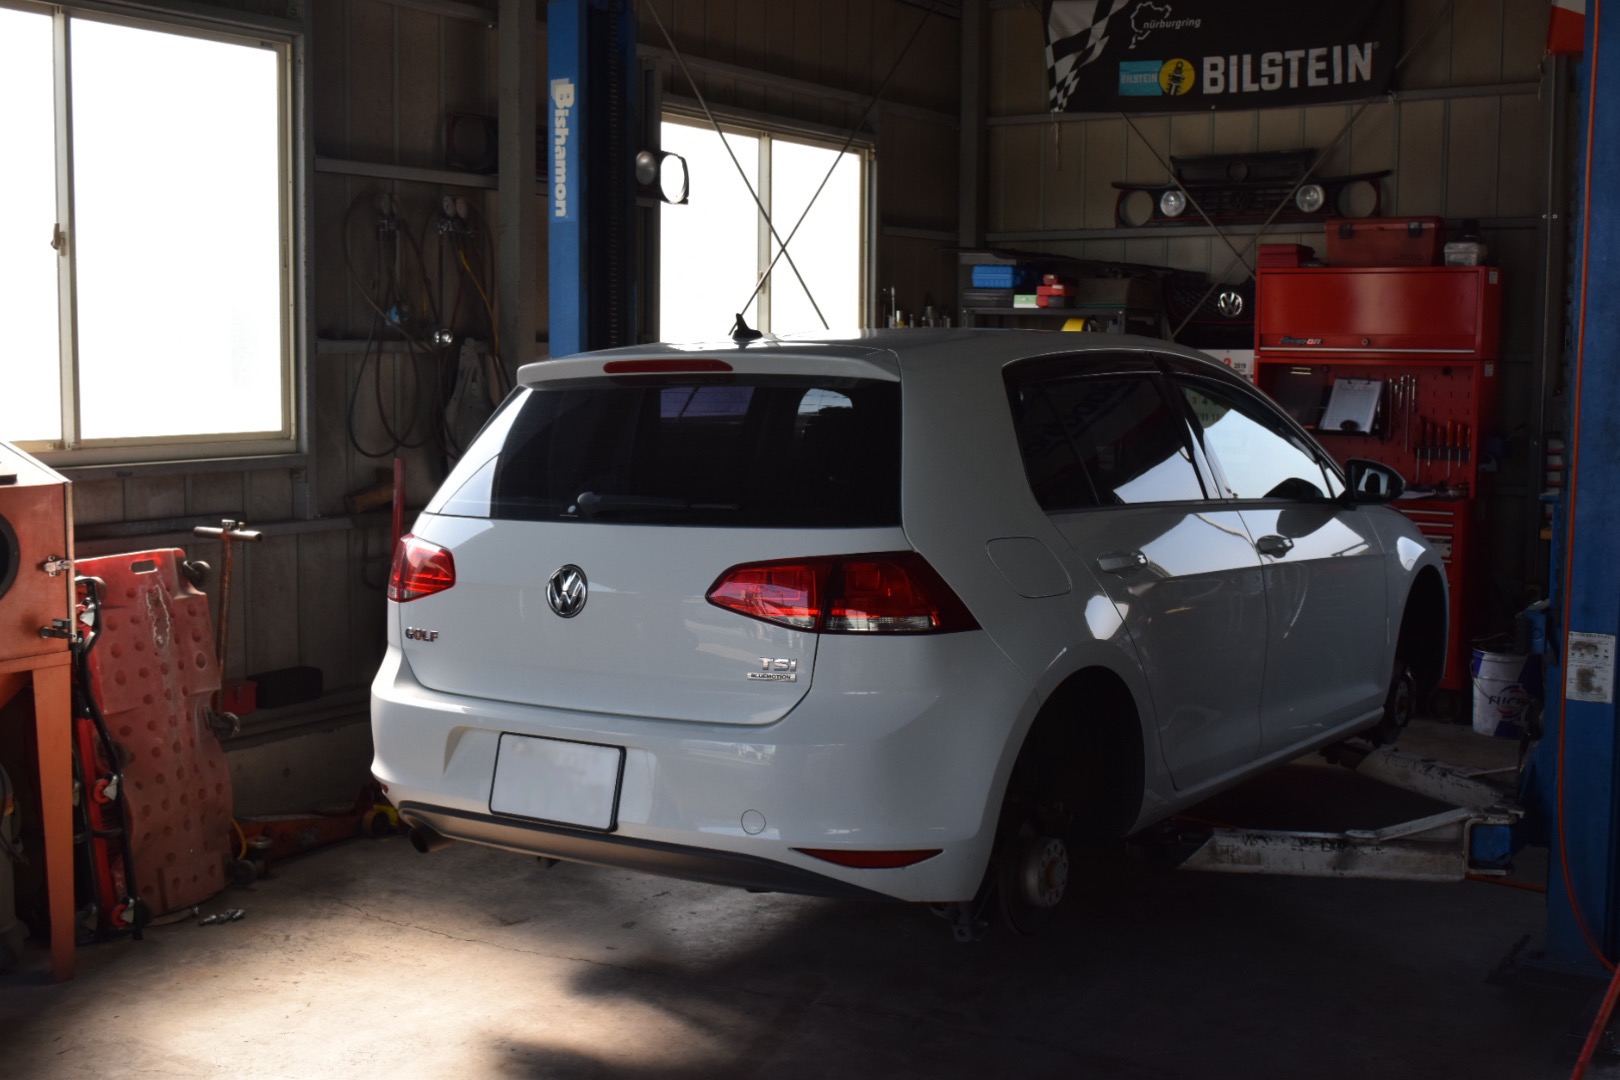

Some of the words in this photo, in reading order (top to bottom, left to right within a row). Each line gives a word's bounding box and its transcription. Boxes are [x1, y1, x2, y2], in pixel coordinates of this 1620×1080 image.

[1142, 18, 1202, 31] nürburgring
[1202, 41, 1373, 95] BILSTEIN
[1120, 73, 1158, 84] BILSTEIN
[550, 78, 575, 217] Bishamon
[405, 626, 439, 642] GOLF
[758, 657, 797, 672] TSI
